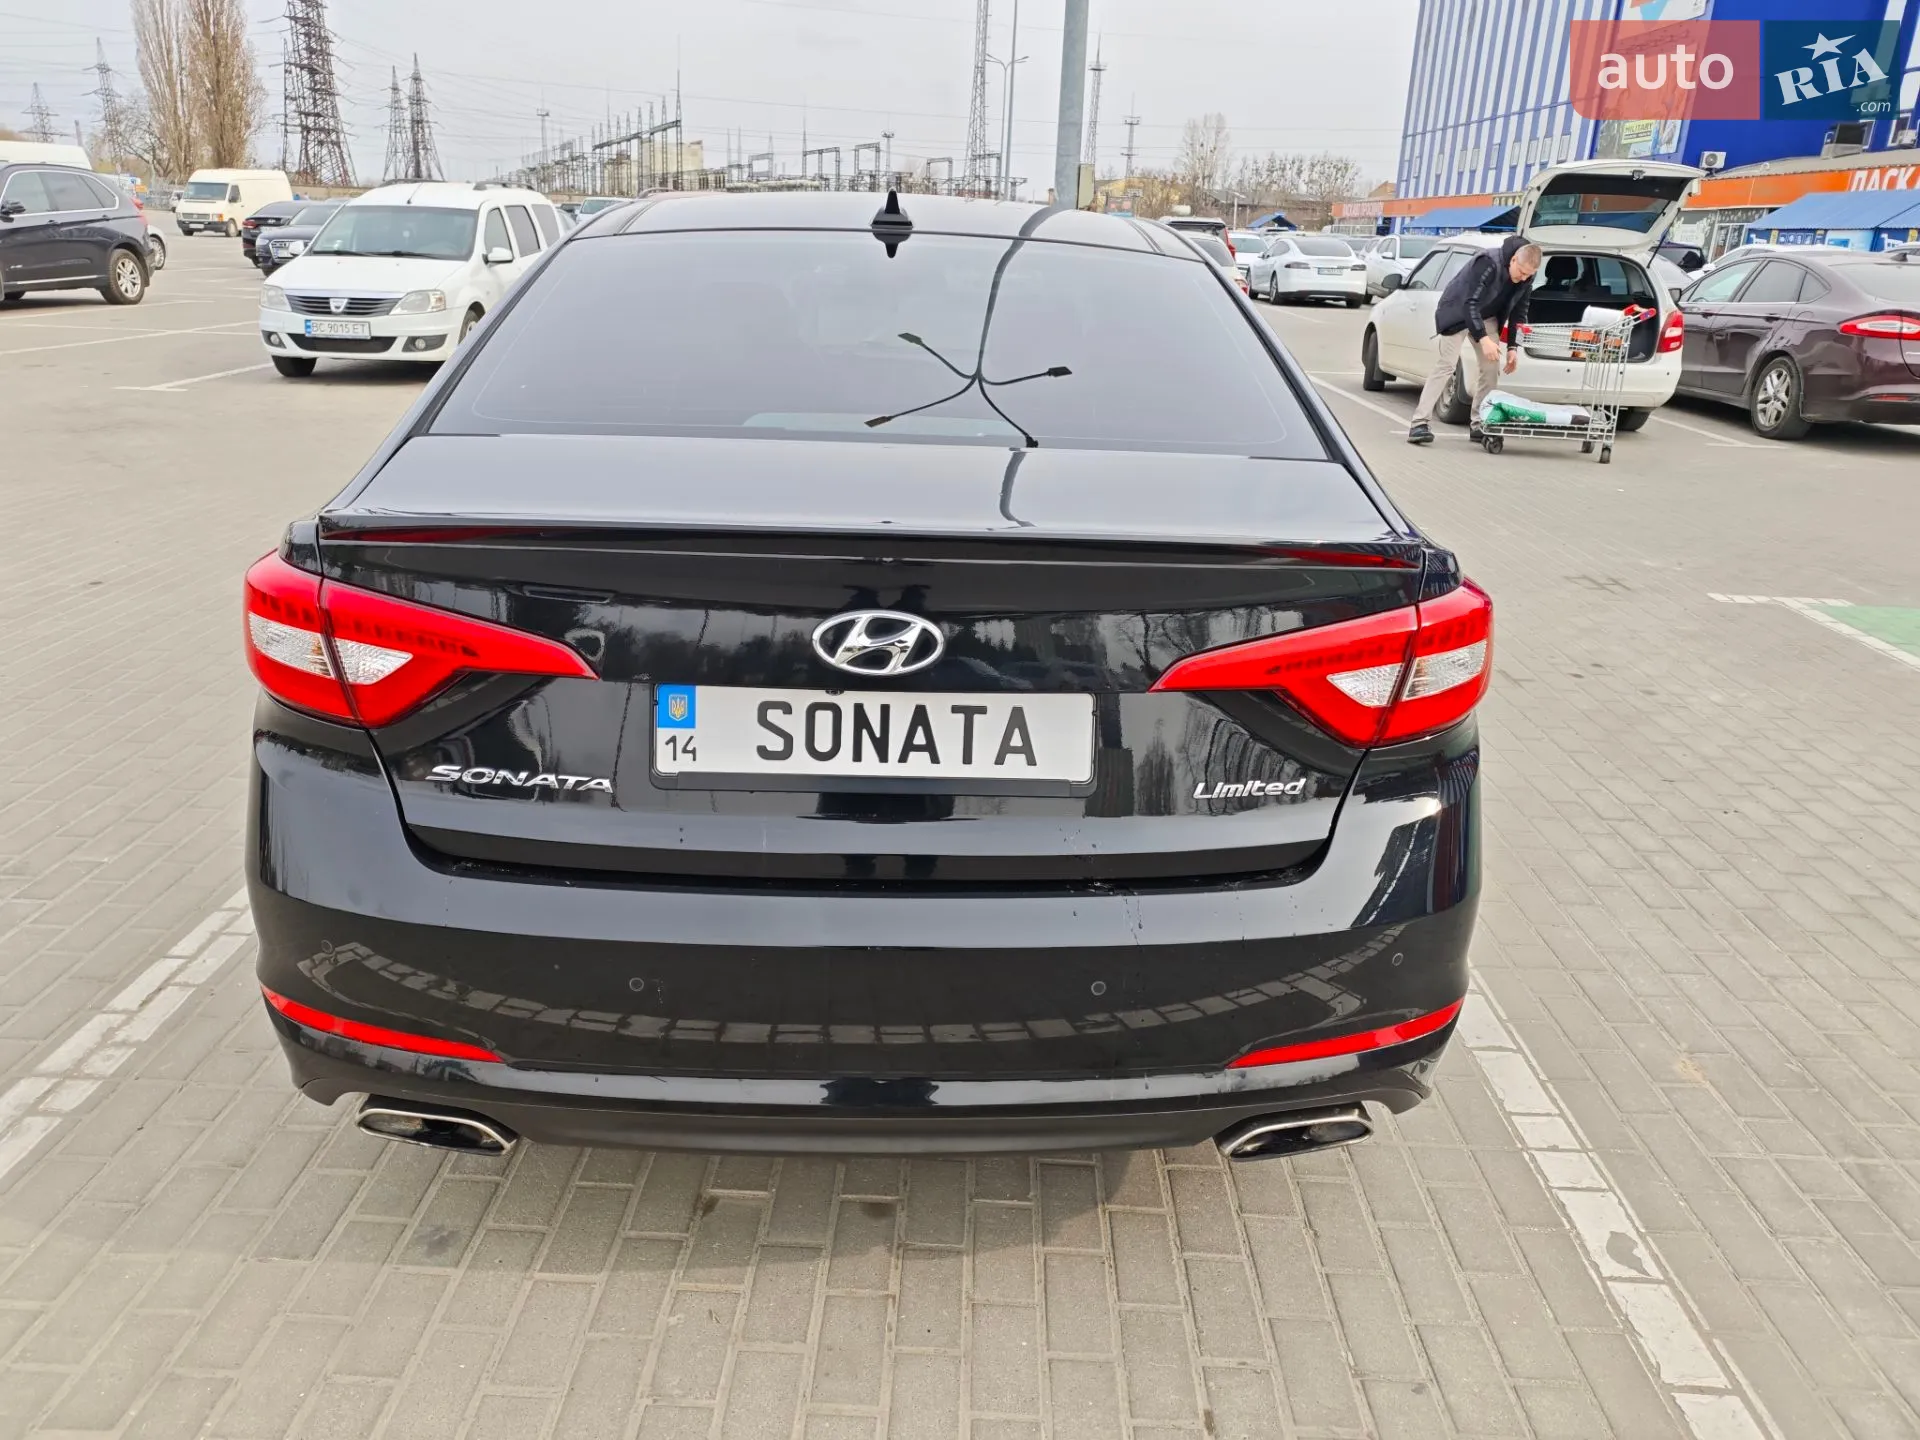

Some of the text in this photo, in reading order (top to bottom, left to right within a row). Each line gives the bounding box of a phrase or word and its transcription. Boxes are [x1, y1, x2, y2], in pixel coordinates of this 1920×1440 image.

[328, 323, 350, 334] 9015
[756, 701, 1038, 767] SONATA
[665, 735, 697, 762] 14
[425, 764, 614, 794] SONATA
[1193, 778, 1307, 799] Limited
